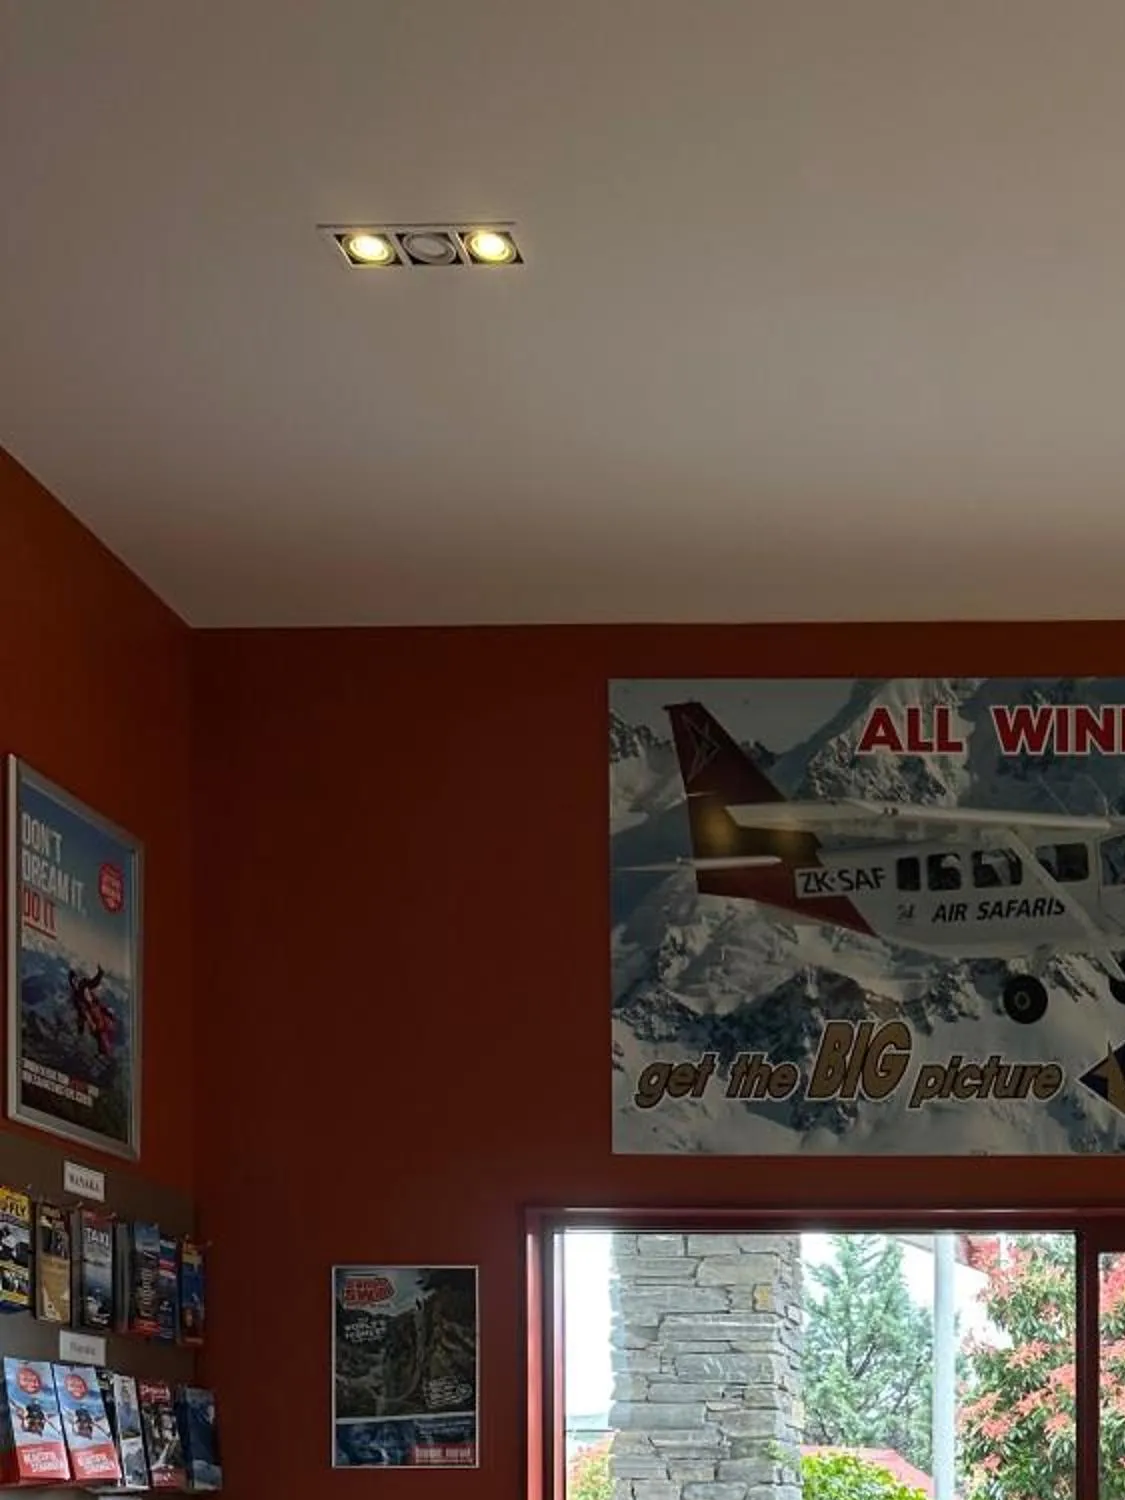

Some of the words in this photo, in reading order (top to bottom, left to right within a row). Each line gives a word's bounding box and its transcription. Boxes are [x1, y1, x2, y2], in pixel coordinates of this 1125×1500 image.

[857, 705, 964, 755] ALL
[21, 811, 62, 865] DON'T
[21, 847, 69, 905] DREAM
[800, 867, 886, 894] ZK-SAF
[932, 902, 967, 922] AIR
[977, 897, 1065, 921] SAFARIS
[634, 1052, 718, 1109] get
[727, 1051, 799, 1099] the
[807, 1020, 912, 1100] BIG
[909, 1054, 1064, 1108] picture
